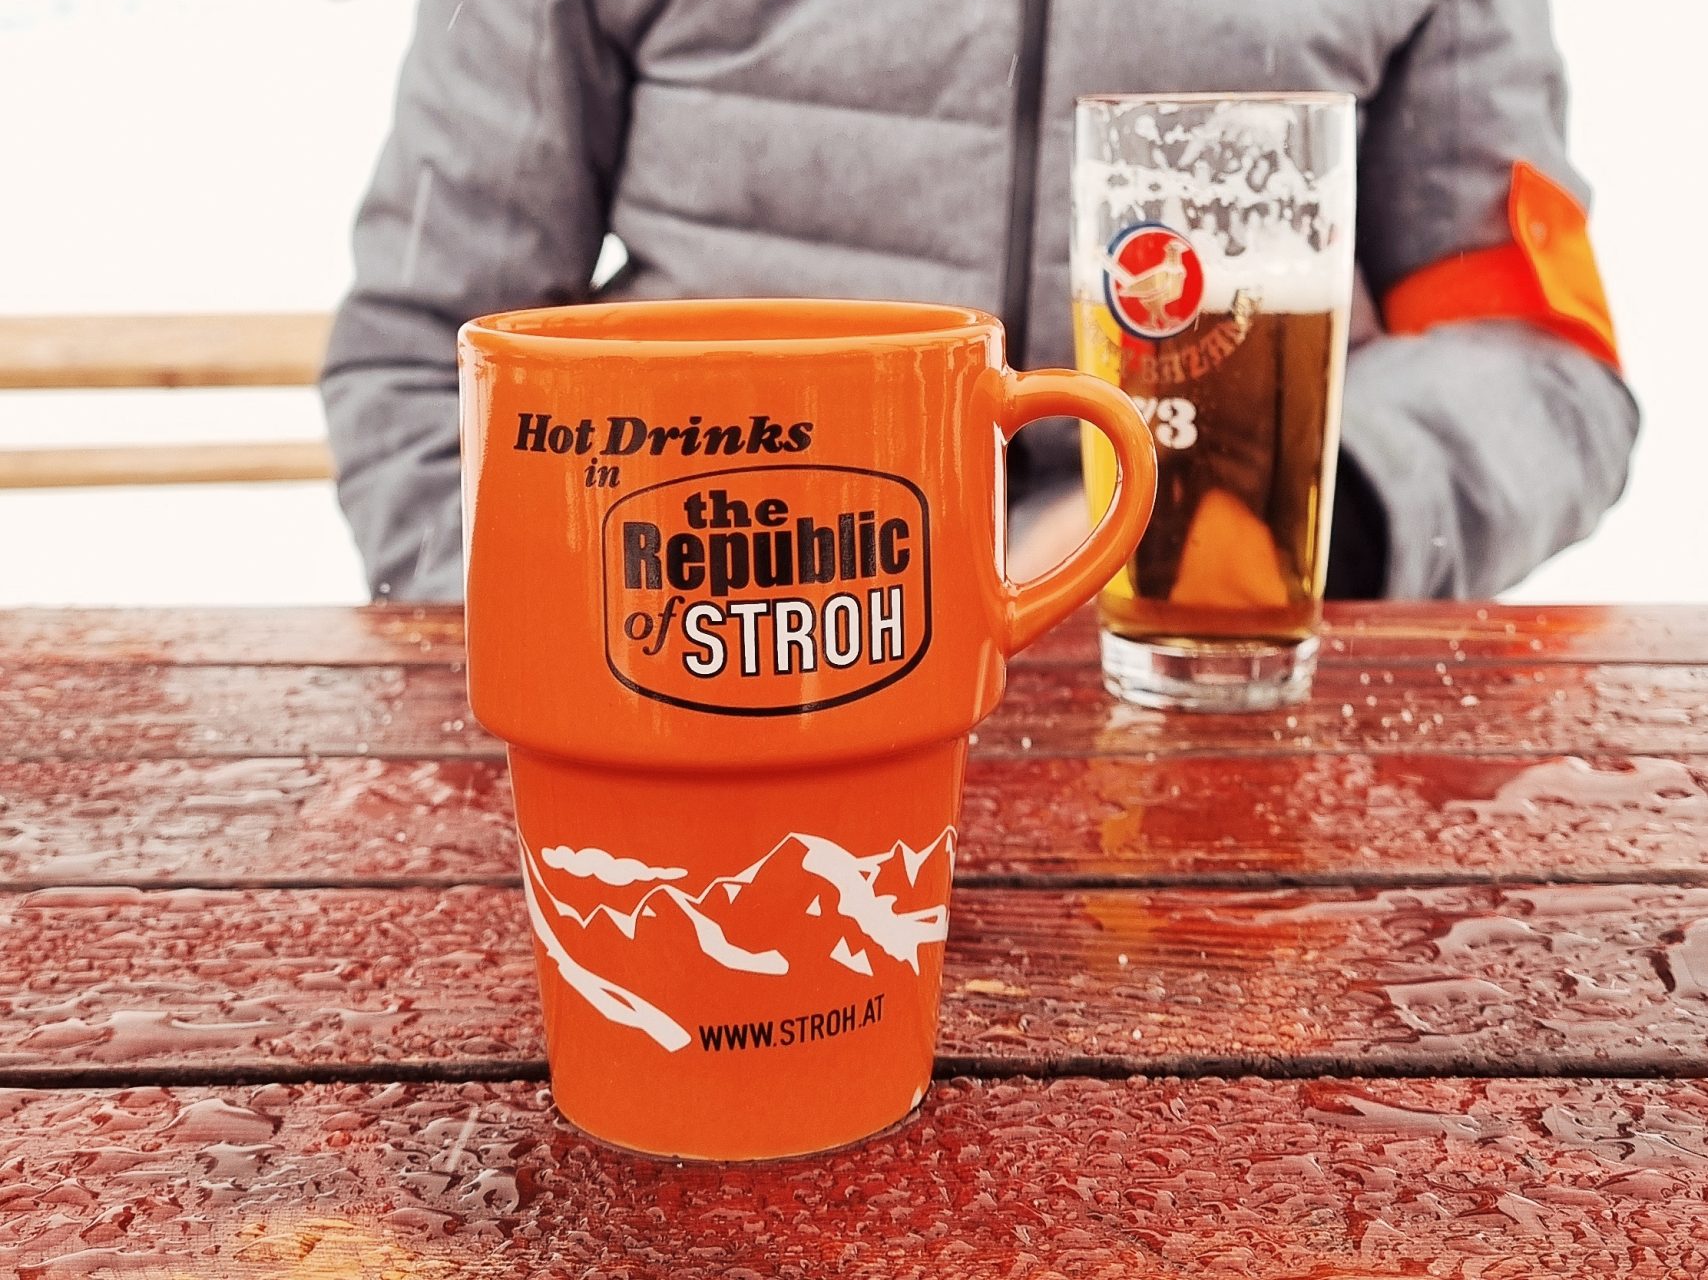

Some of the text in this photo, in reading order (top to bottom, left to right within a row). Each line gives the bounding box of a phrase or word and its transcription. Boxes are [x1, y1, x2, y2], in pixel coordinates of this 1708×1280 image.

[513, 412, 815, 457] Hot Drinks
[583, 458, 621, 489] in
[683, 490, 790, 529] the
[622, 510, 911, 597] Republic
[623, 583, 906, 679] of STROH
[698, 993, 886, 1053] WWW.STROH.AT
